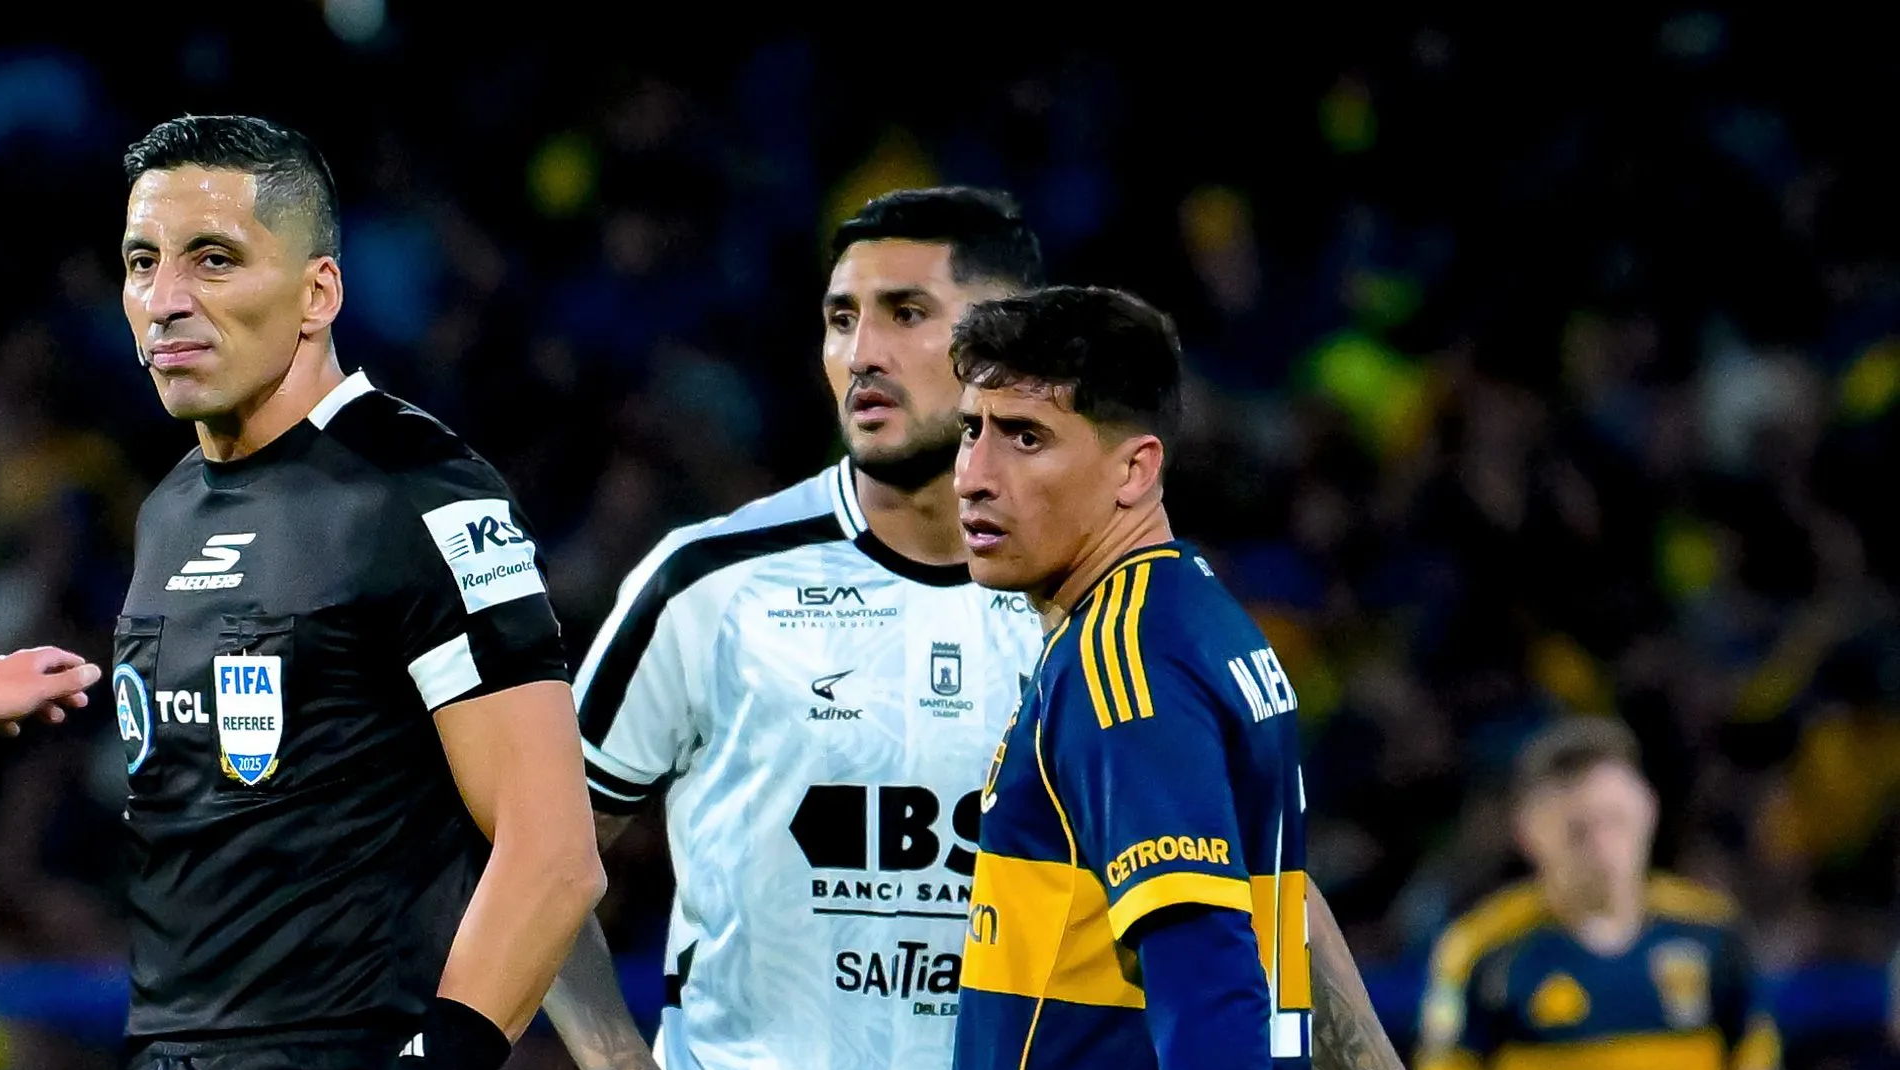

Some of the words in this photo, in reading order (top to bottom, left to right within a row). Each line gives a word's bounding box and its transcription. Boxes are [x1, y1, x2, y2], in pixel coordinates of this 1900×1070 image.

[164, 572, 245, 591] SKECHERS
[797, 586, 865, 605] ISM
[835, 607, 898, 618] SANTIAGO
[220, 666, 273, 694] FIFA
[155, 690, 210, 723] TCL
[919, 698, 974, 711] SANTIAGO
[222, 716, 276, 731] REFEREE
[238, 757, 262, 772] 2025
[1106, 836, 1230, 888] CETROGAR
